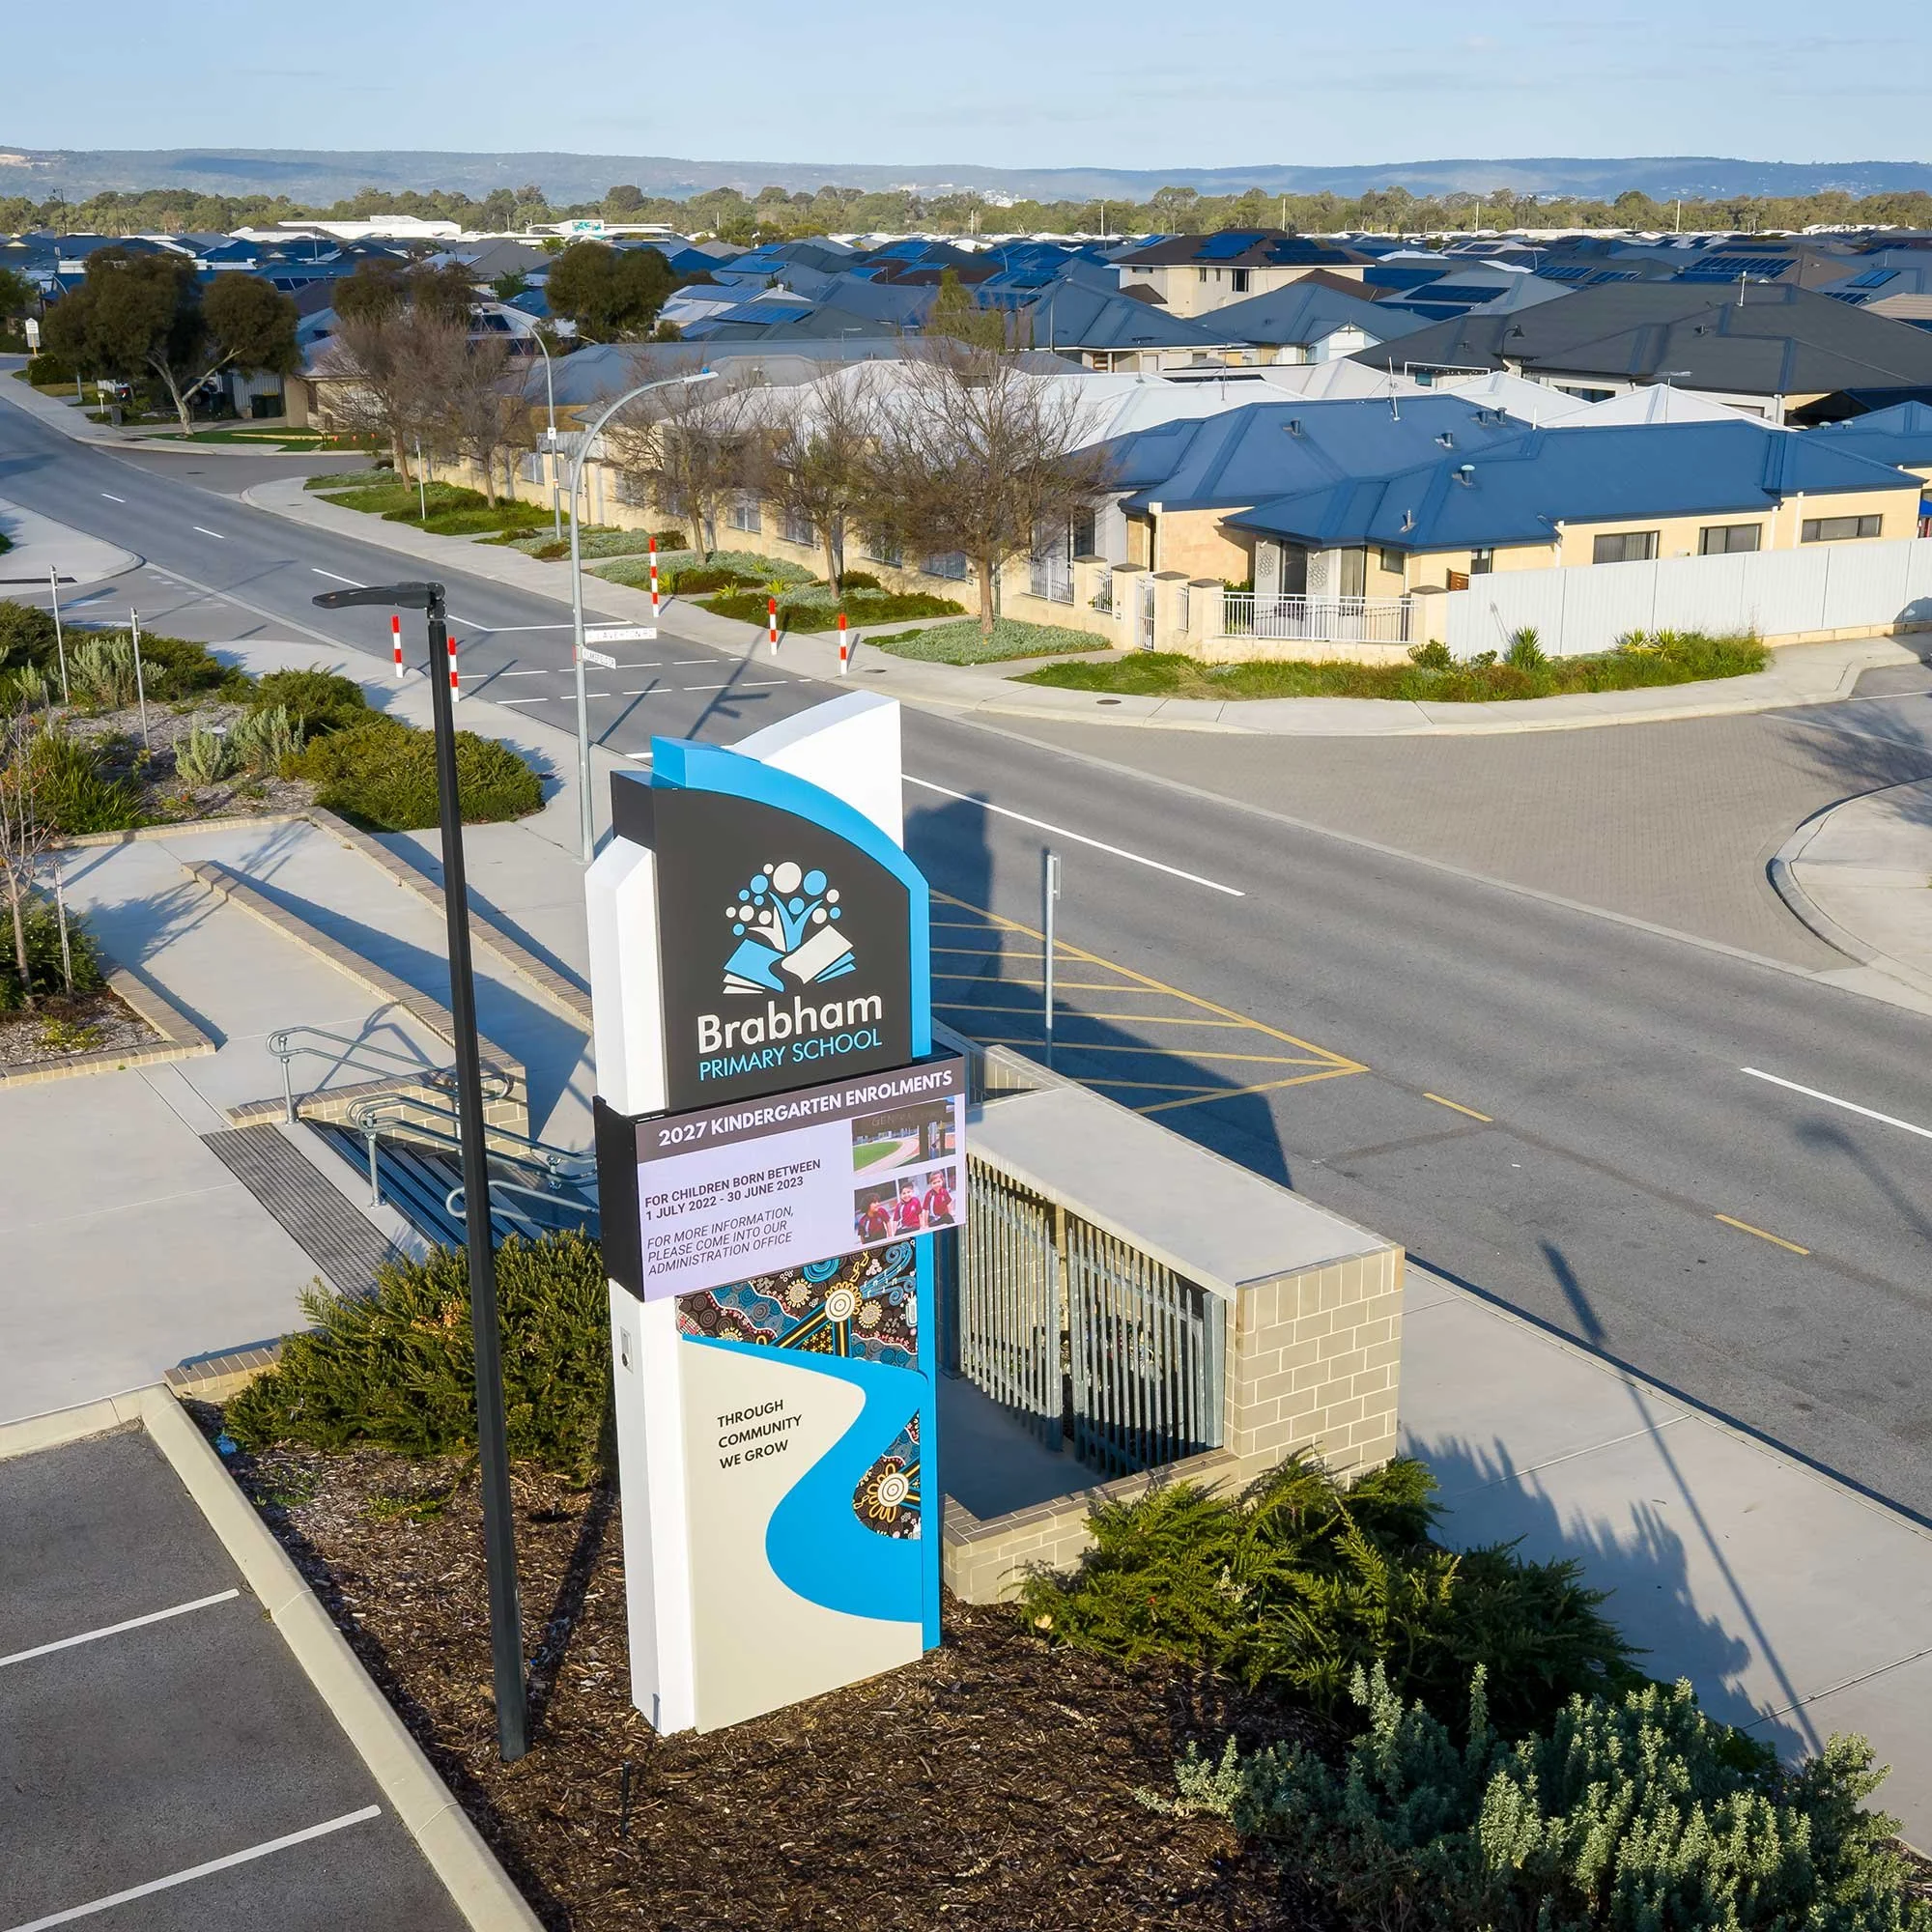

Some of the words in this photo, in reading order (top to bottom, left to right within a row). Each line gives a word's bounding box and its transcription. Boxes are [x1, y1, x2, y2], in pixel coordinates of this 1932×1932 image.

[697, 995, 882, 1054] Brabham
[699, 1045, 786, 1081] PRIMARY
[792, 1028, 883, 1064] SCHOOL
[659, 1121, 708, 1147] 2027
[711, 1093, 841, 1135] KINDERGARTEN
[845, 1069, 952, 1107] ENROLMENTS
[644, 1194, 668, 1208] FOR
[671, 1179, 730, 1202] CHILDREN
[732, 1171, 765, 1188] BORN
[768, 1159, 821, 1179] BETWEEN
[645, 1210, 652, 1221] 1
[656, 1202, 686, 1219] JULY
[688, 1196, 717, 1212] 2022
[727, 1190, 742, 1203] 30
[744, 1182, 774, 1199] JUNE
[777, 1176, 804, 1191] 2023
[647, 1235, 670, 1249] FOR
[673, 1225, 709, 1243] MORE
[711, 1206, 794, 1235] INFORMATION,
[647, 1243, 694, 1263] PLEASE
[696, 1234, 730, 1249] COME
[732, 1226, 760, 1242] INTO
[763, 1220, 787, 1235] OUR
[648, 1242, 750, 1276] ADMINISTRATION
[753, 1232, 793, 1250] OFFICE
[717, 1399, 783, 1428] THROUGH
[718, 1414, 802, 1448] COMMUNITY
[720, 1453, 741, 1469] WE
[745, 1439, 788, 1462] GROW
